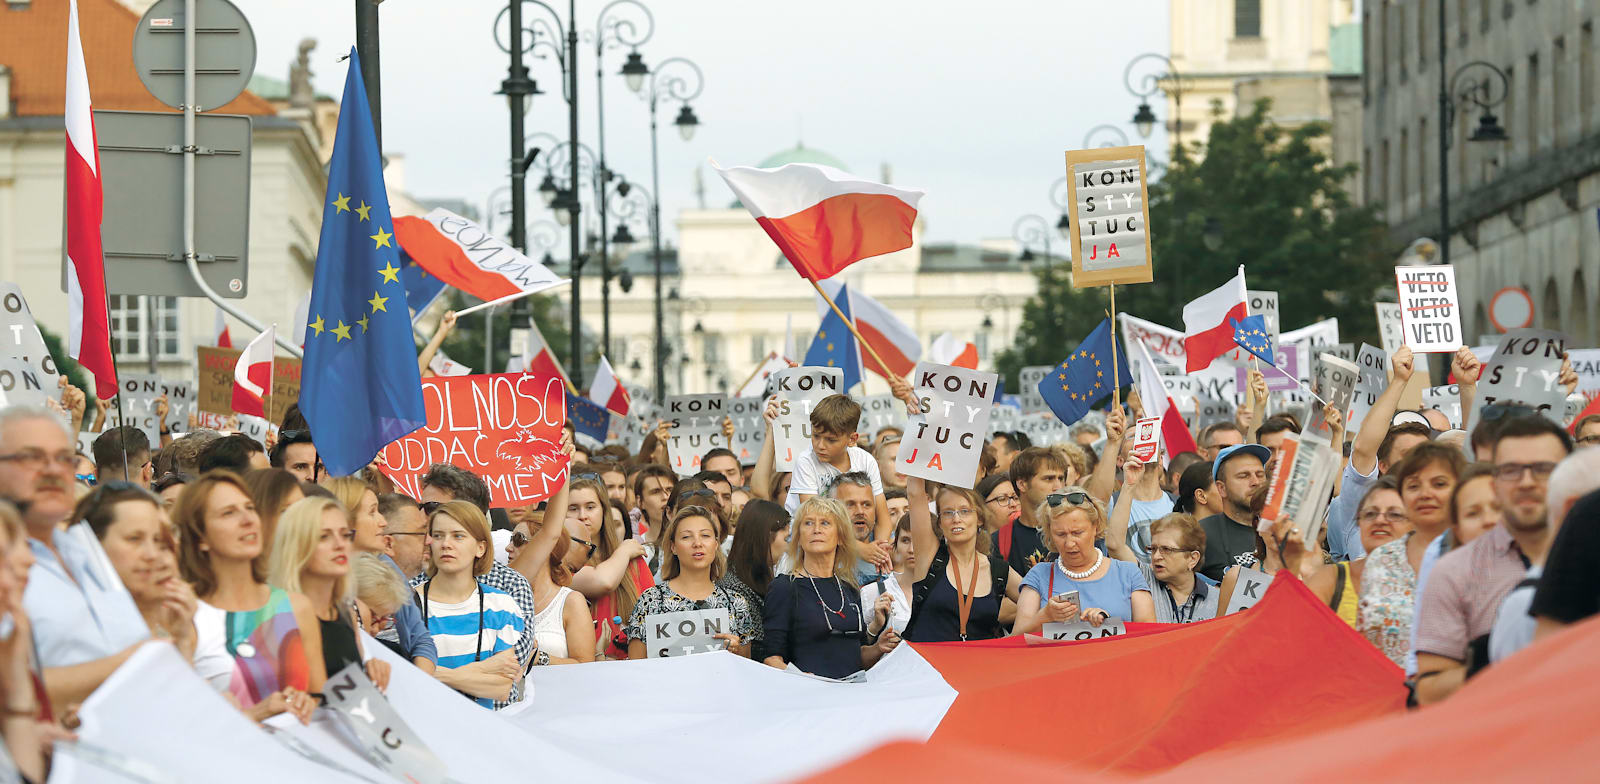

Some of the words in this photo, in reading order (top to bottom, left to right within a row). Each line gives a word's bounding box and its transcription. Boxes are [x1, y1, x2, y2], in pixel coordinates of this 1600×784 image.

[1083, 169, 1134, 187] KON
[1086, 193, 1135, 212] STY
[1089, 217, 1136, 235] TUC
[1090, 243, 1120, 260] JA
[1405, 272, 1448, 293] VETO
[1408, 297, 1451, 318] VETO
[1412, 322, 1454, 344] VETO
[1502, 338, 1564, 359] KON
[1319, 366, 1353, 388] KON
[1489, 365, 1560, 392] STY
[1572, 361, 1600, 376] ZĄ
[778, 376, 836, 391] KON
[921, 372, 987, 398] KON
[414, 372, 566, 433] OLNOŚCI
[672, 399, 721, 412] KON
[920, 397, 982, 423] STY
[672, 416, 720, 428] STY
[672, 433, 719, 448] TUC
[917, 423, 974, 449] TUC
[384, 431, 489, 471] ODDAĆ
[677, 455, 701, 468] JA
[906, 448, 943, 470] JA
[389, 474, 428, 501] NI
[483, 466, 568, 502] MIEM
[656, 618, 721, 639] KON
